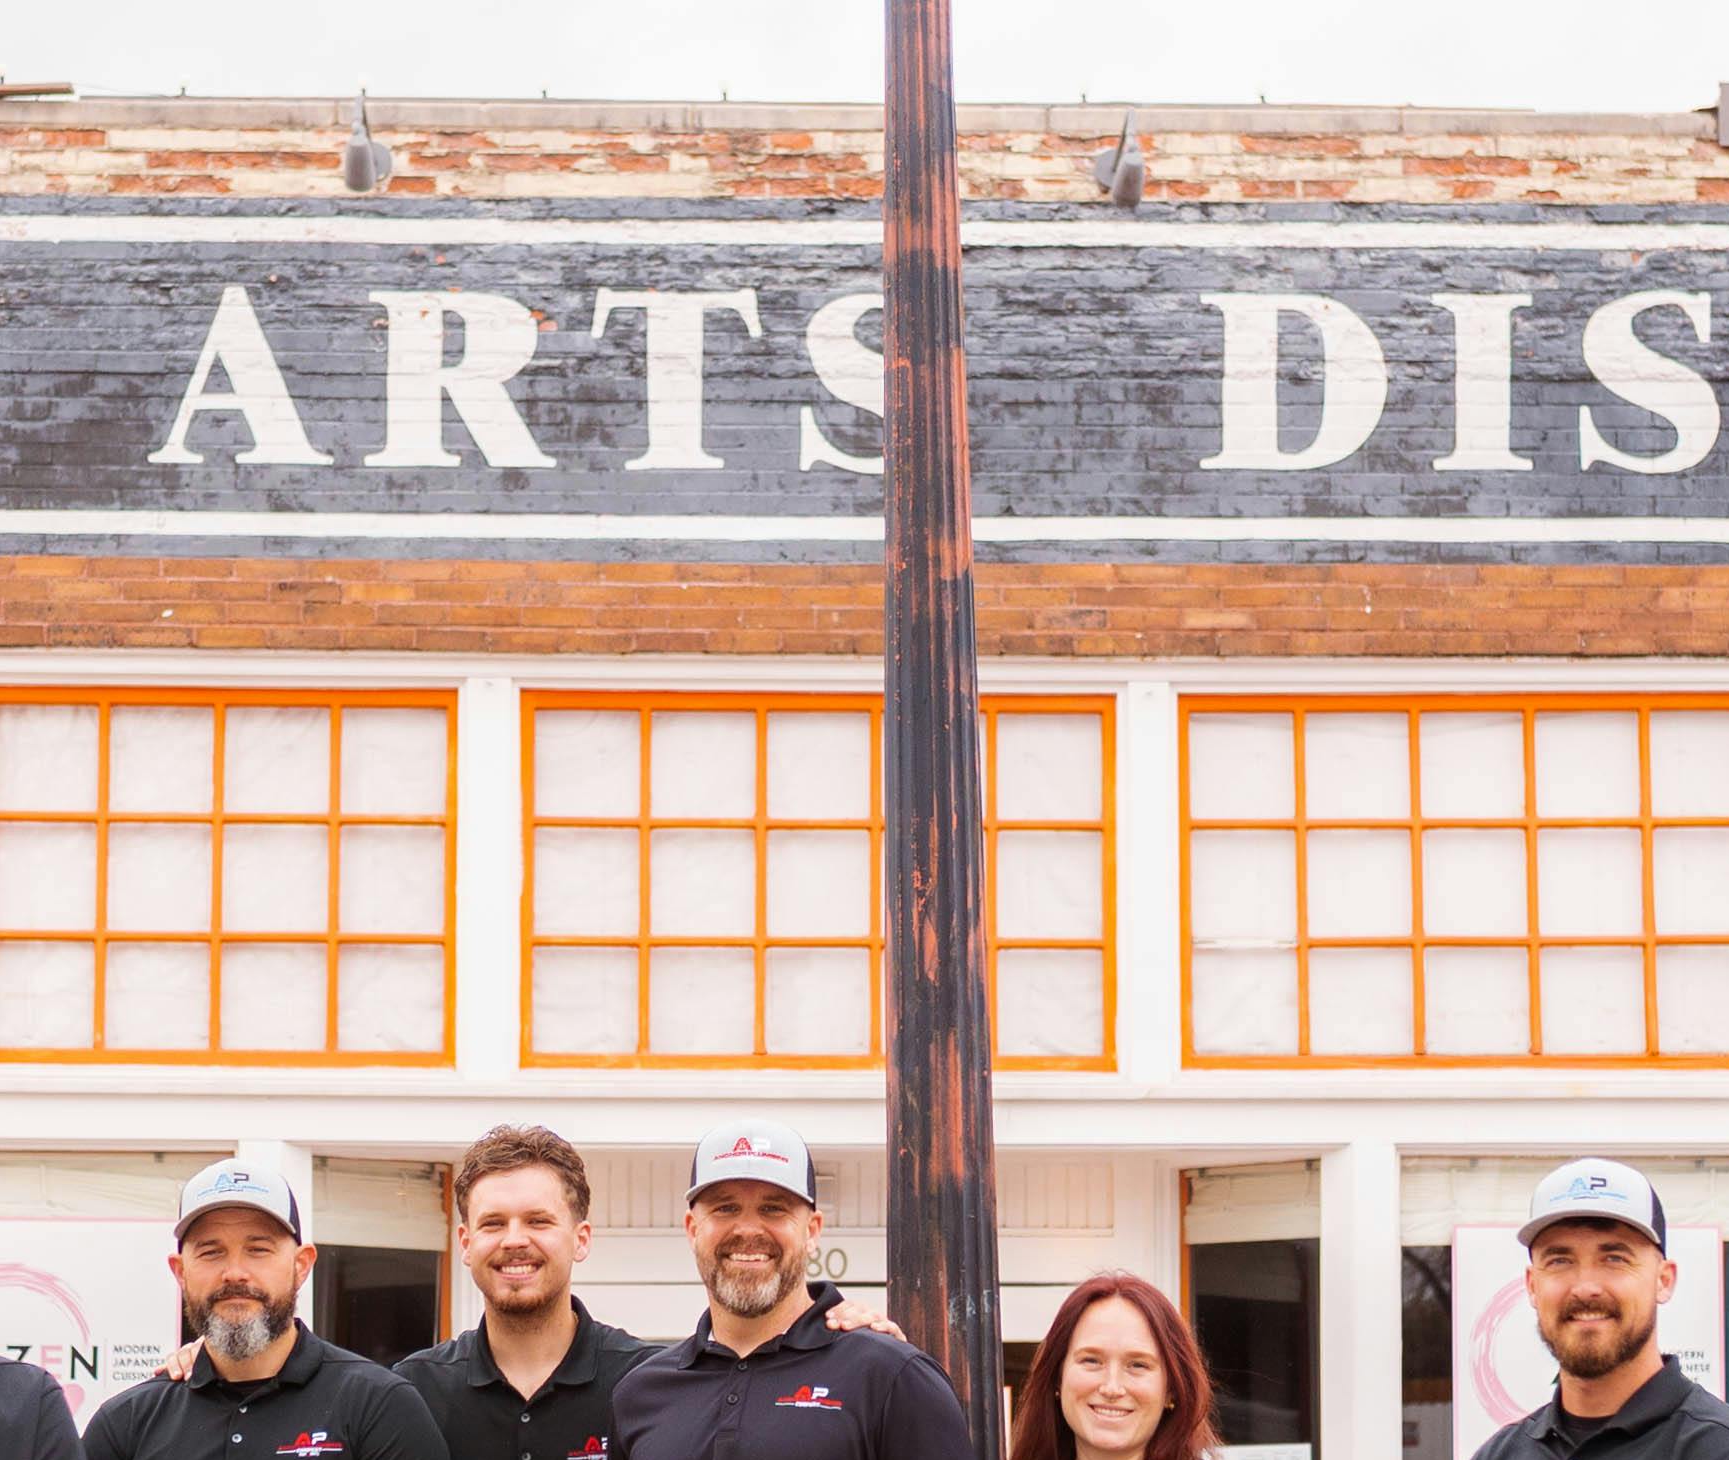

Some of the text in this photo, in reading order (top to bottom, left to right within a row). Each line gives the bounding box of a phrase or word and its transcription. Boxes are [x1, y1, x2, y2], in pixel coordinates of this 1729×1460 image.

[147, 286, 884, 473] ARTS
[214, 1172, 249, 1187] AP
[1568, 1177, 1606, 1193] AP
[112, 1345, 161, 1354] MODERN
[112, 1371, 152, 1381] CUISIN
[794, 1385, 829, 1401] AP
[295, 1432, 327, 1447] AP
